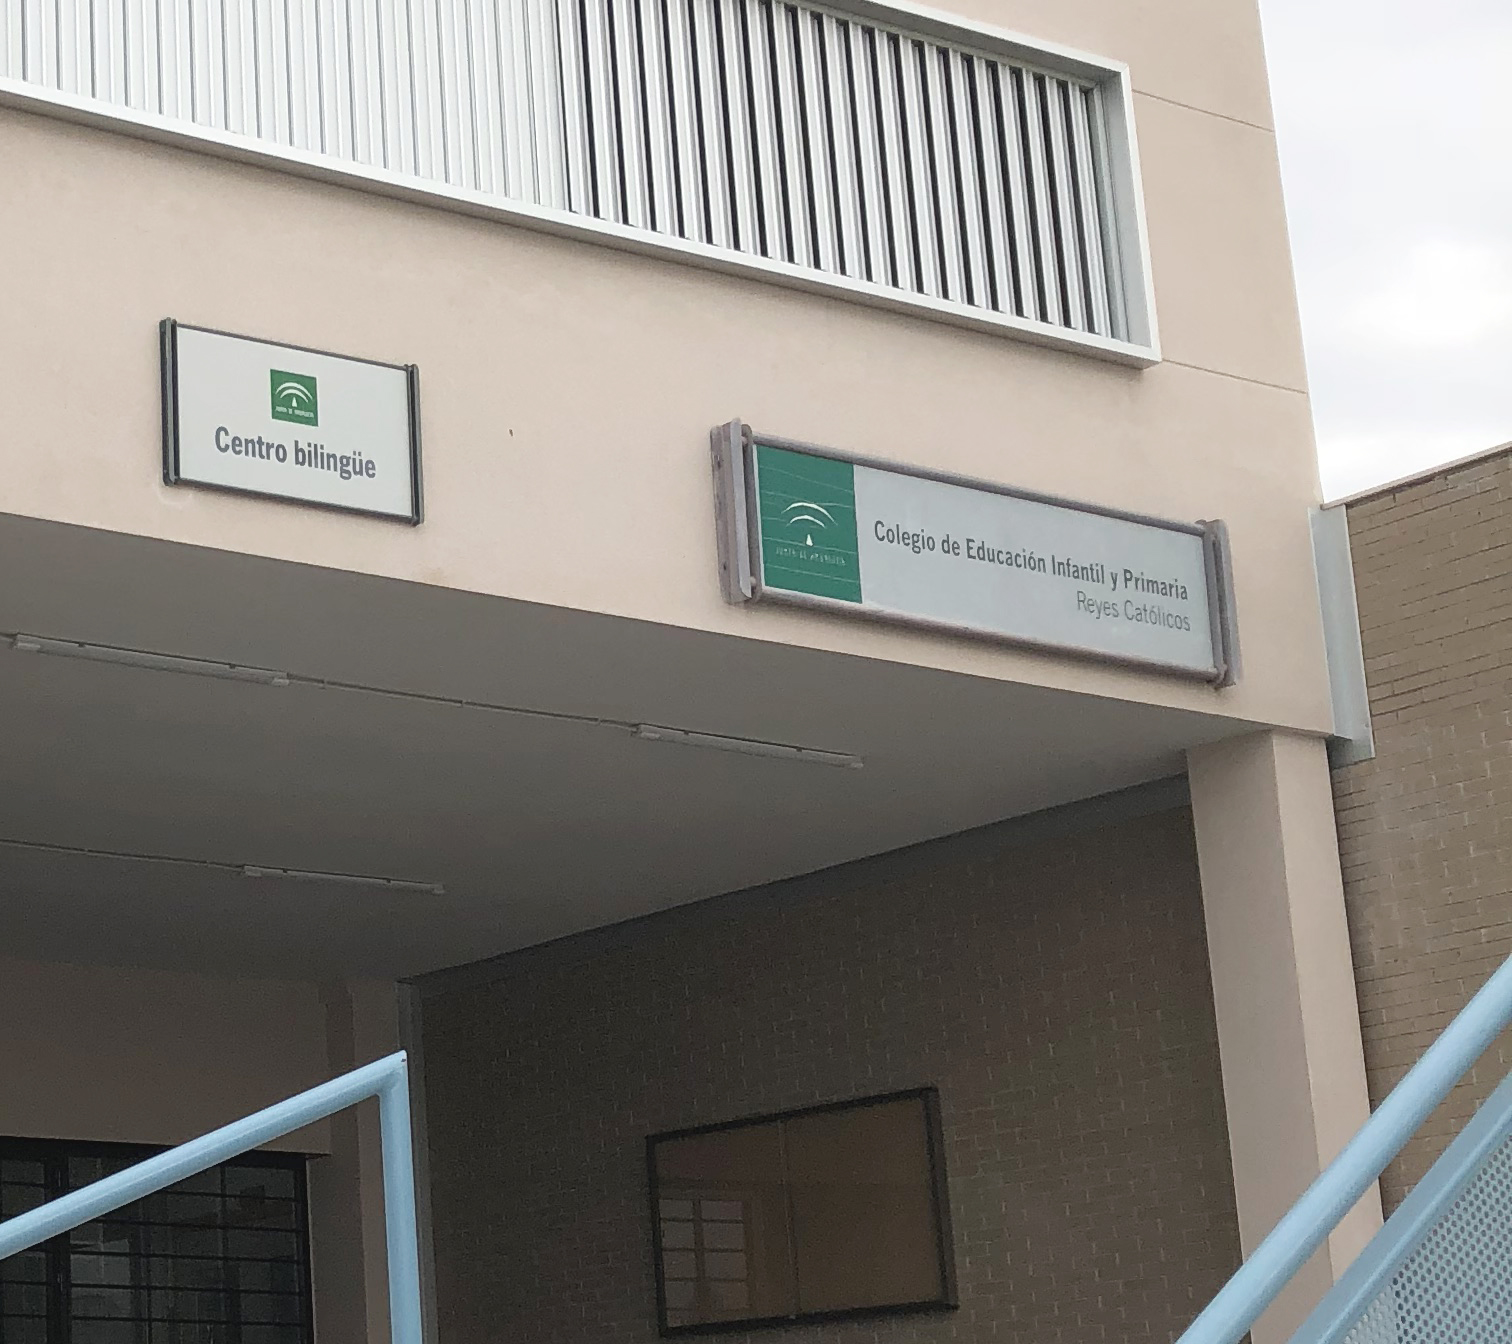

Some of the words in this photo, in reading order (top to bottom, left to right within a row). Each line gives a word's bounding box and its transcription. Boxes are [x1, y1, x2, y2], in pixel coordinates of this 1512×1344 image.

[215, 426, 287, 463] Centro
[294, 440, 376, 480] bilingüe
[874, 520, 936, 554] Colegio
[941, 534, 961, 556] de
[966, 538, 1047, 573] Educación
[1051, 555, 1105, 585] Infantil
[1110, 571, 1118, 591] y
[1123, 568, 1188, 600] Primaria
[1076, 590, 1120, 619] Reyes
[1124, 600, 1191, 631] Católicos
